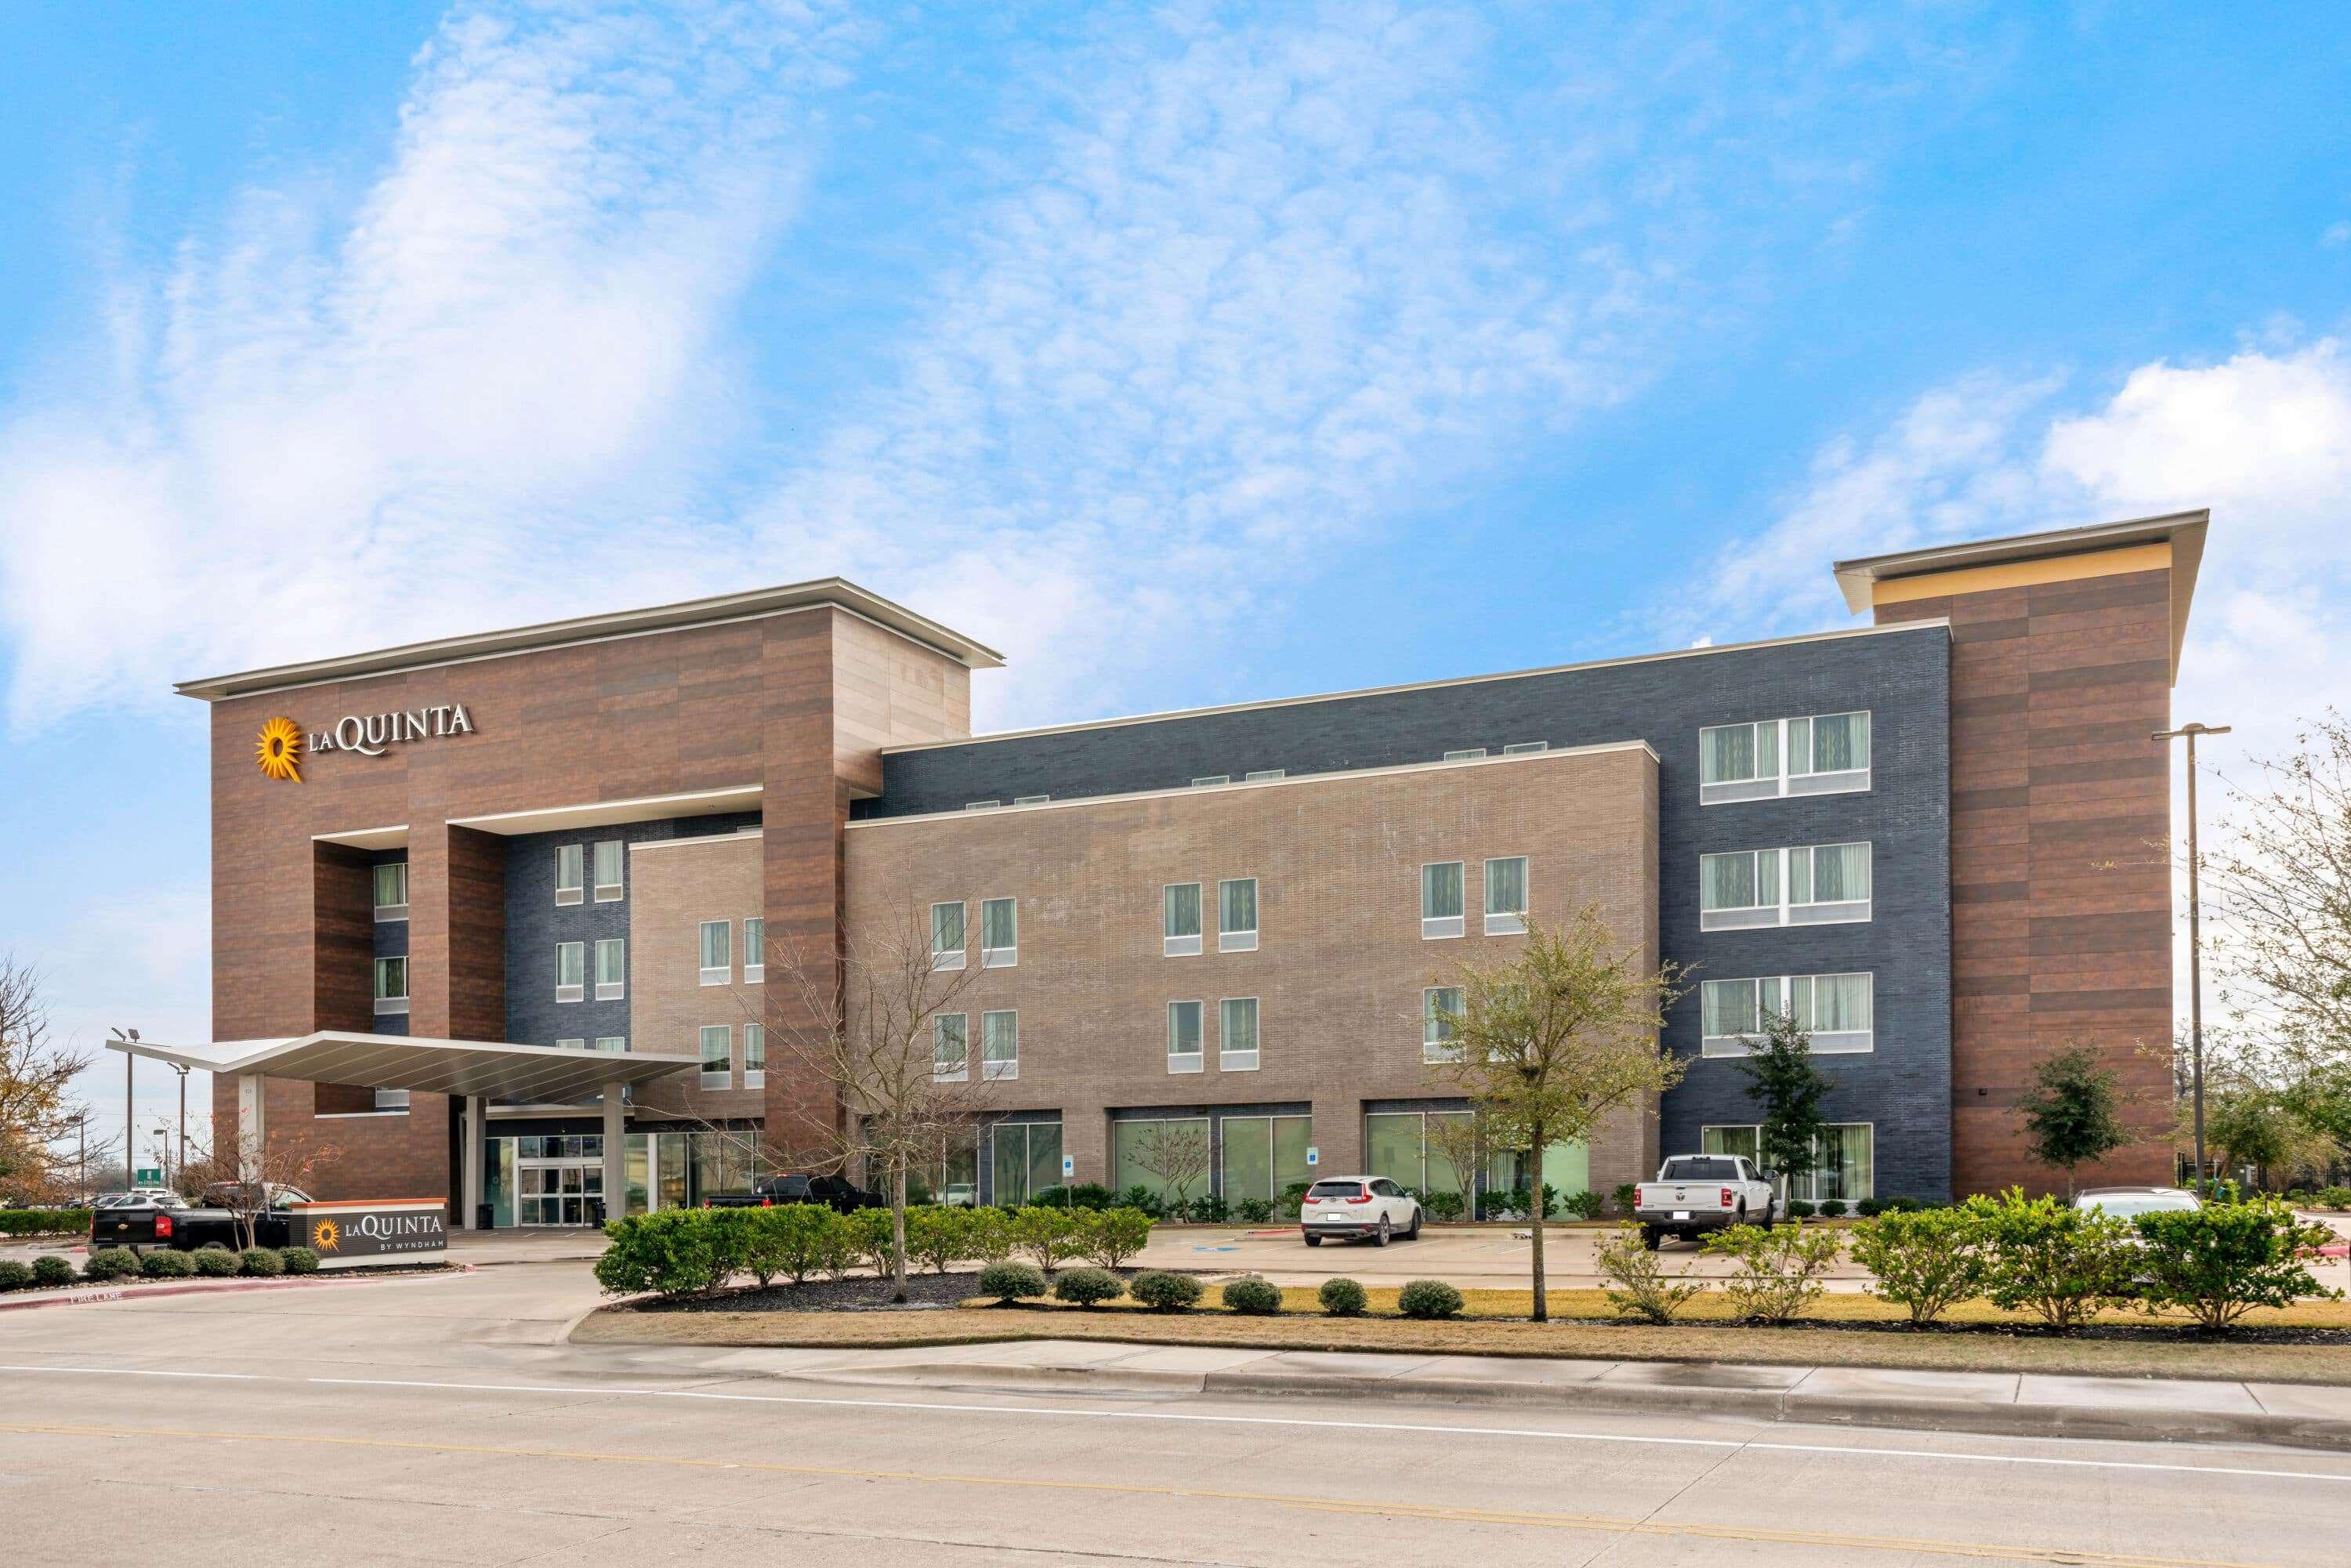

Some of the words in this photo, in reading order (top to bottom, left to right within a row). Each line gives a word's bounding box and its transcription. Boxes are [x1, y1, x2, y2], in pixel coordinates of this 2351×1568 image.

[309, 730, 336, 752] LA
[335, 703, 474, 755] QUINTA
[346, 1224, 361, 1237] LA
[361, 1215, 443, 1240] QUINTA
[396, 1240, 444, 1251] WYNDHAM
